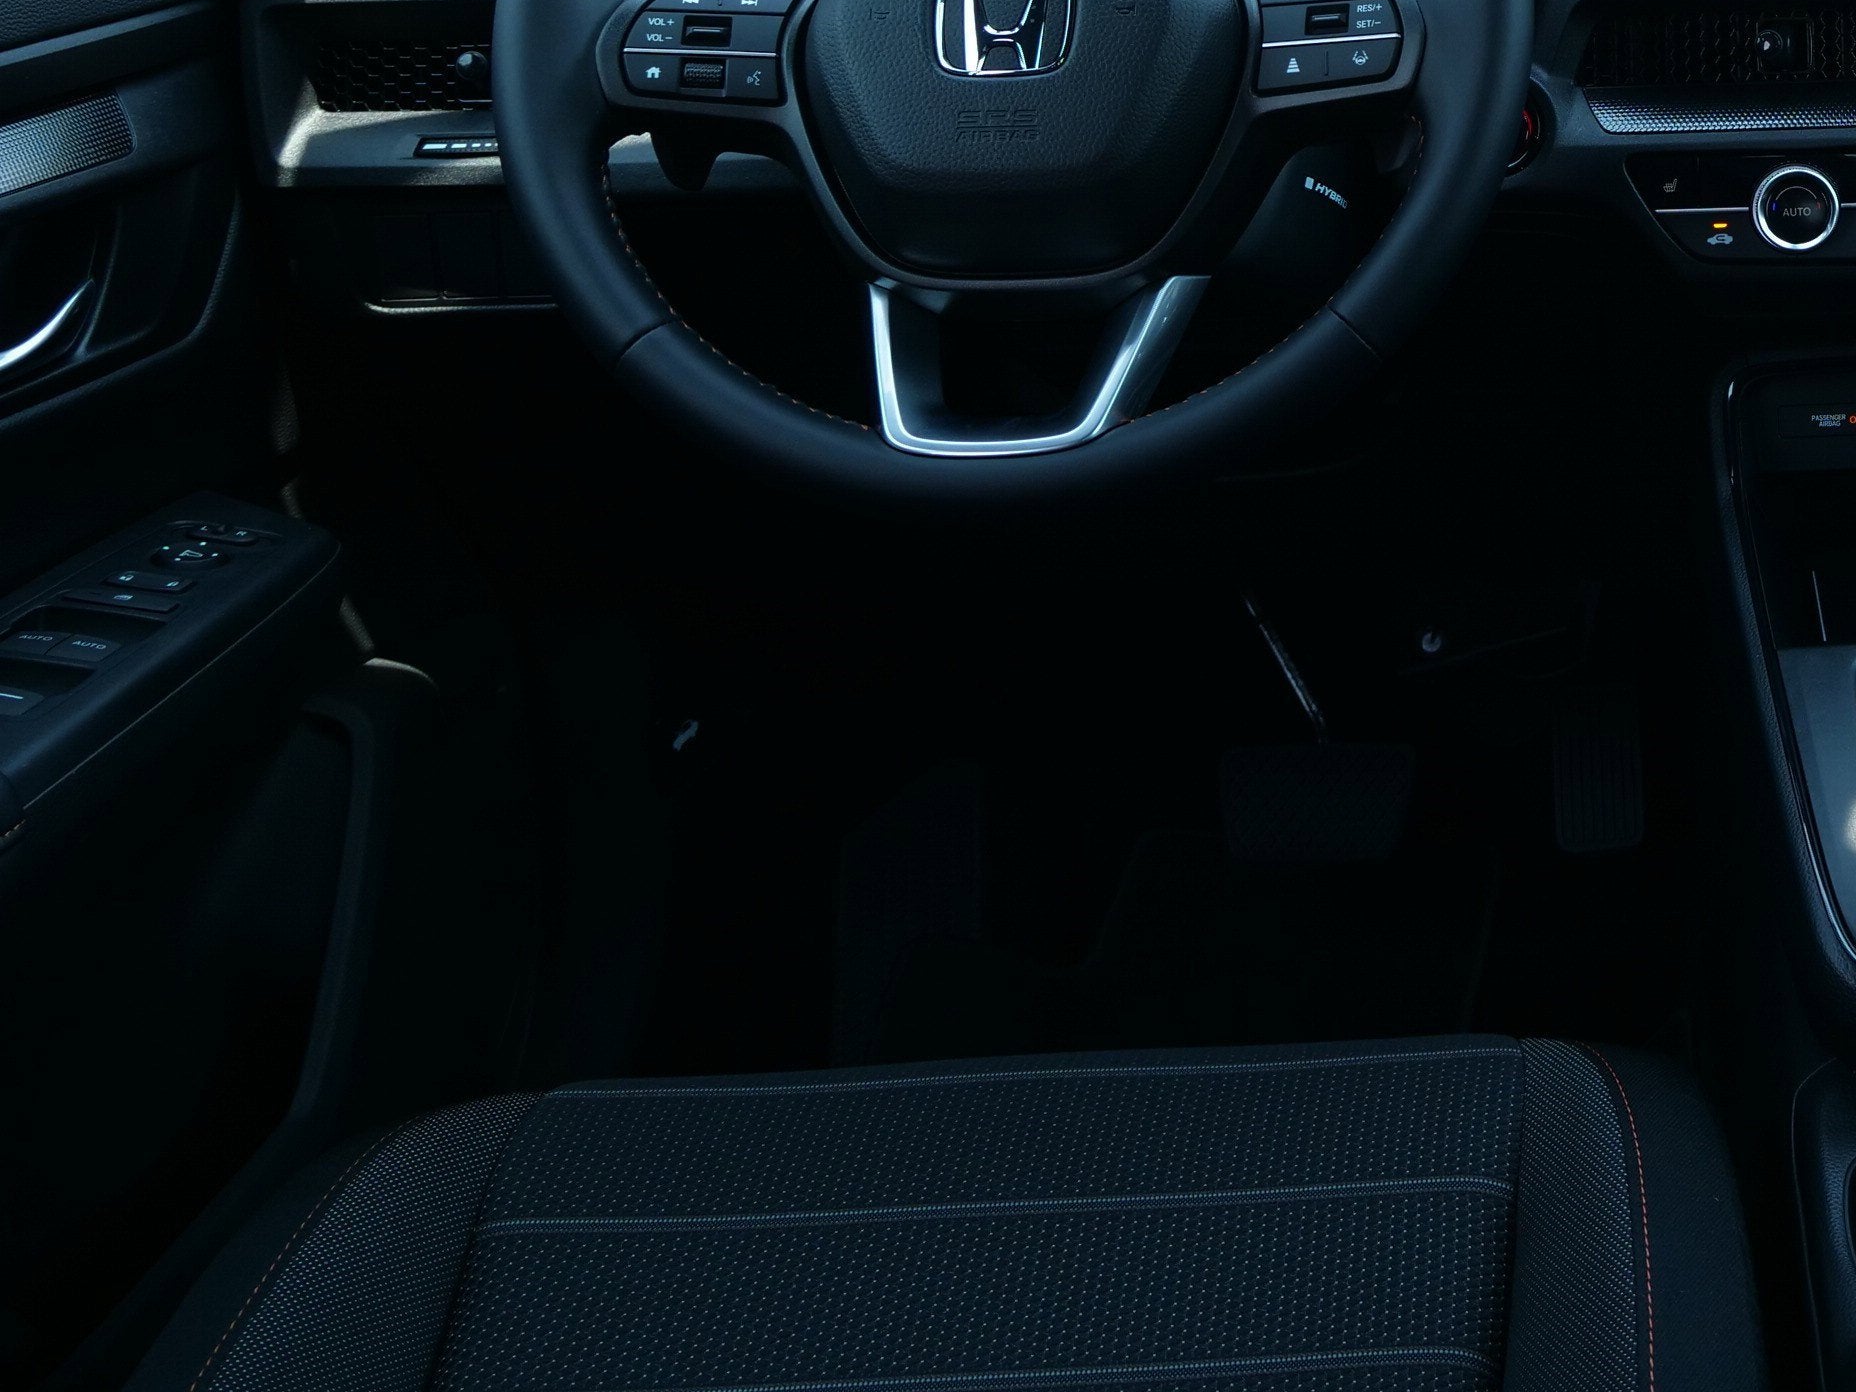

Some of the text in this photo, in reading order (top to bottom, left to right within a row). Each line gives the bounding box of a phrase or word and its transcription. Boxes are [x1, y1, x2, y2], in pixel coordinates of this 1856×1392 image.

[957, 109, 1038, 125] SRS
[956, 130, 1040, 142] AIRBAG
[1314, 182, 1348, 209] HYBRID
[1782, 208, 1812, 216] AUTO
[19, 633, 53, 642] AUTO
[72, 640, 106, 650] AUTO
